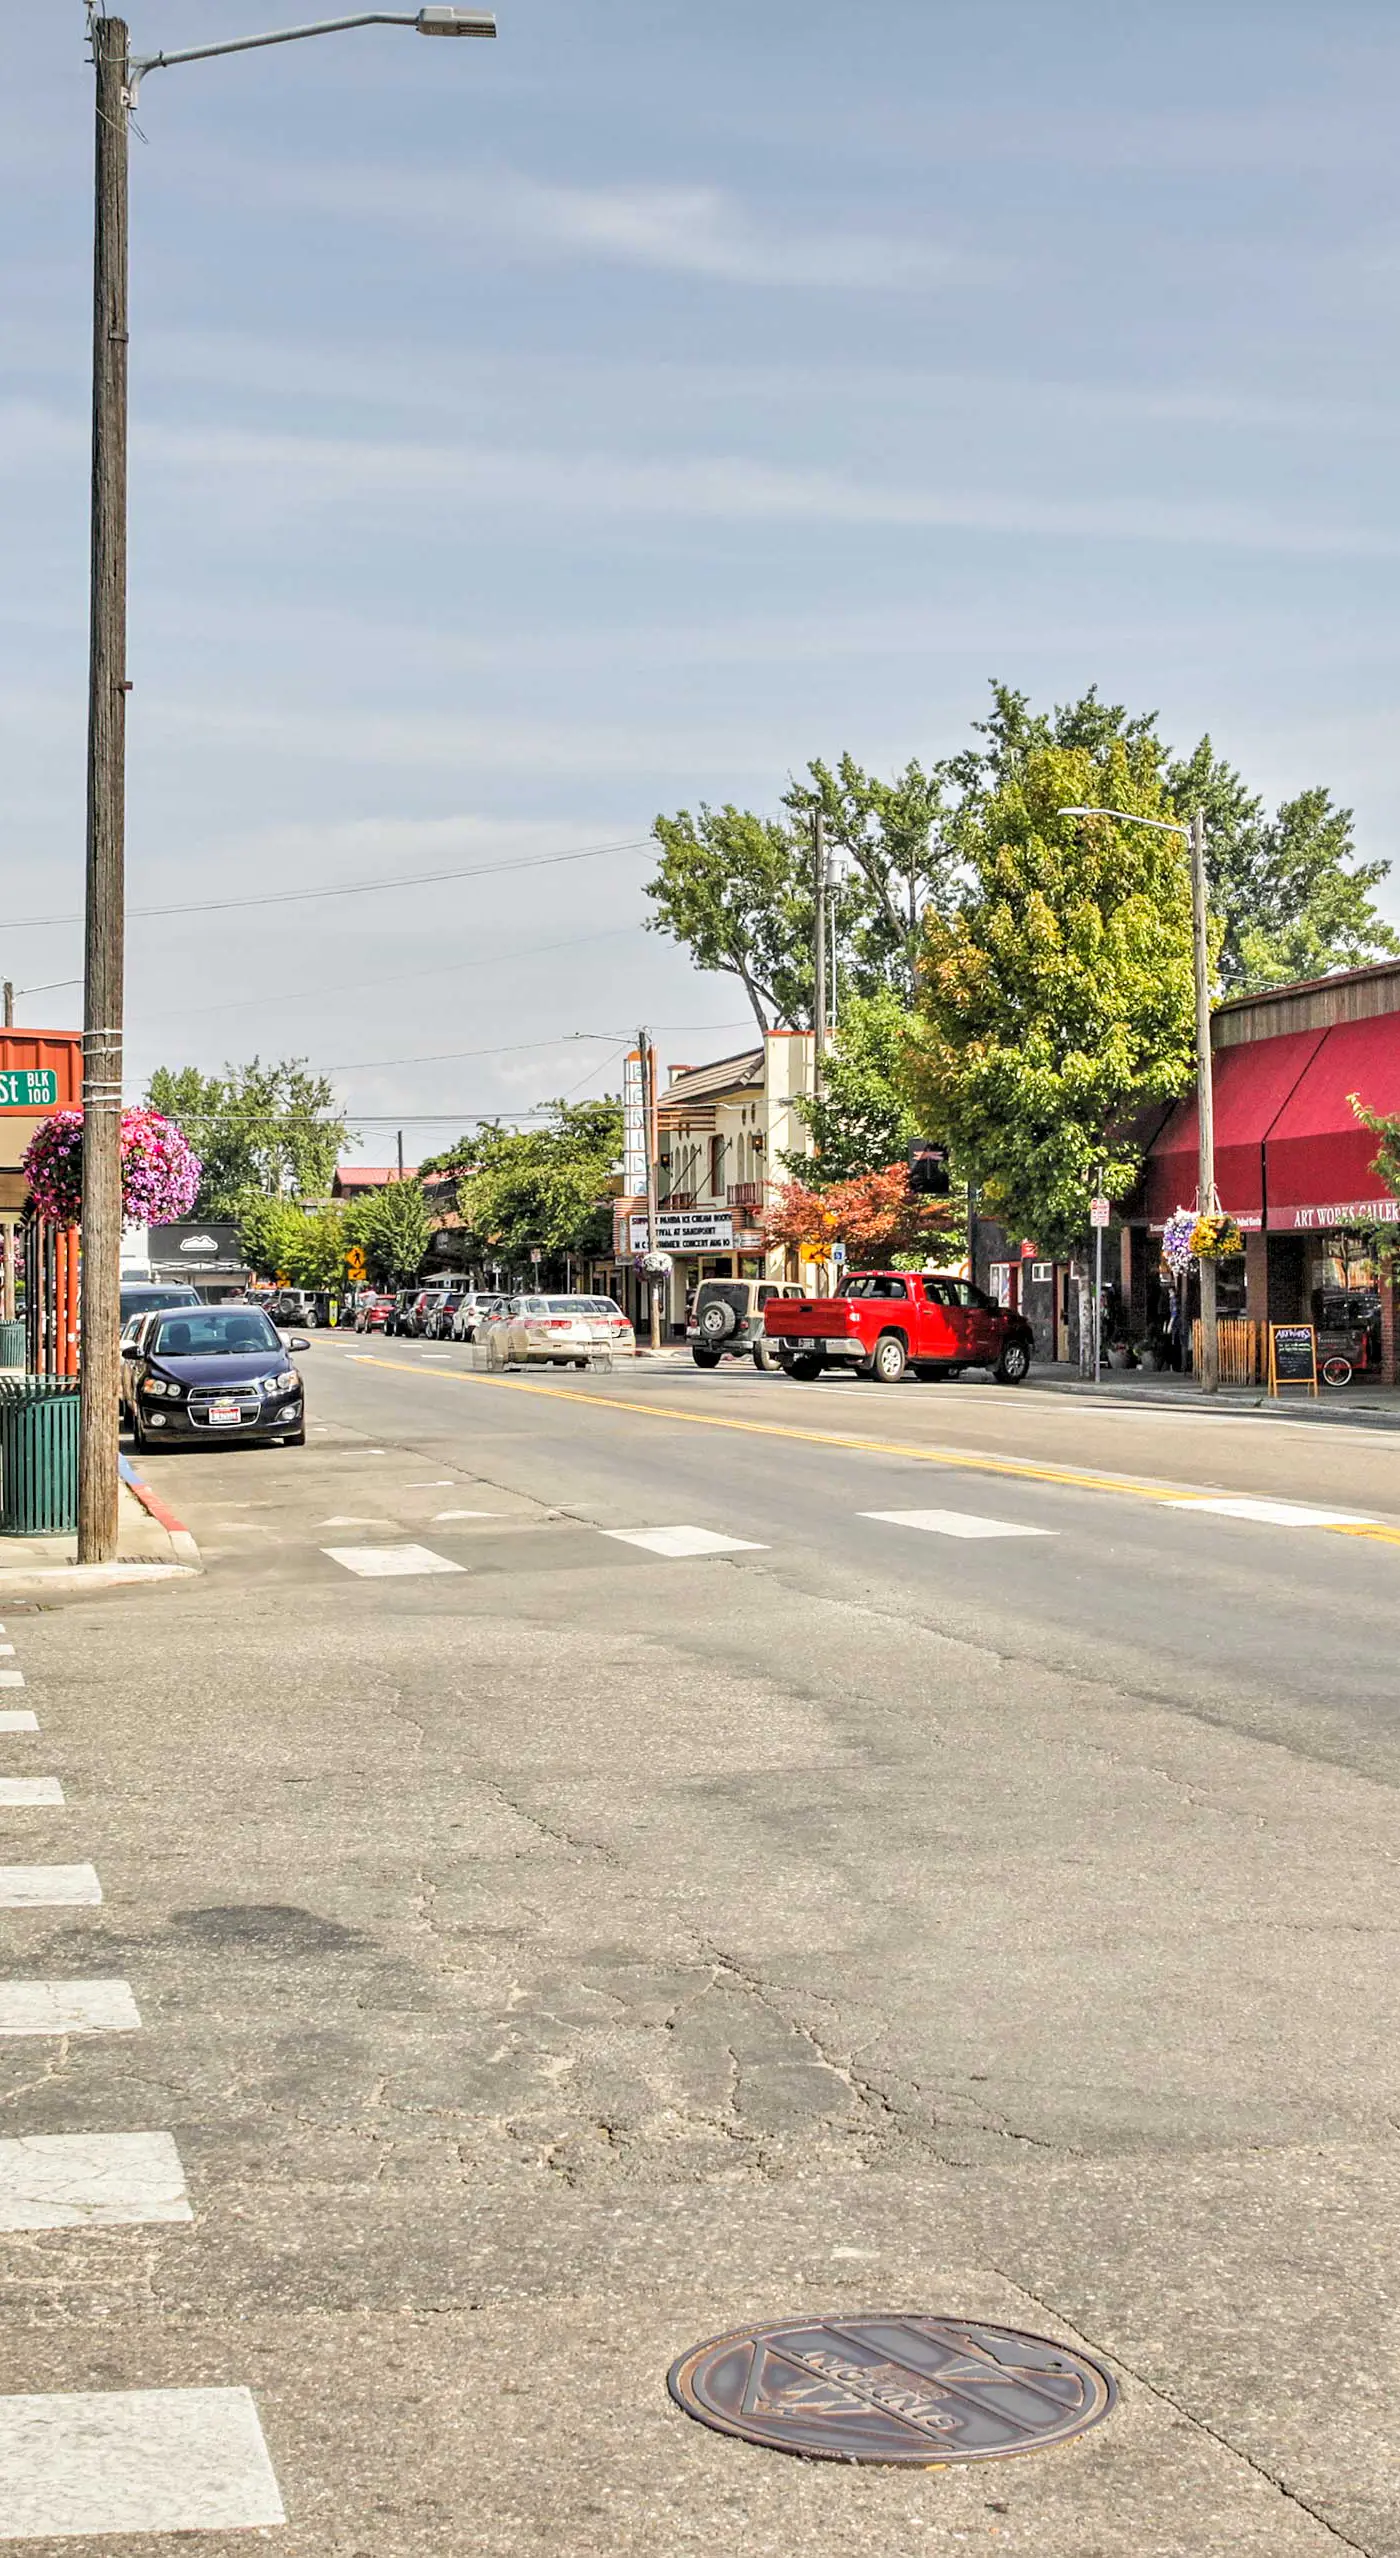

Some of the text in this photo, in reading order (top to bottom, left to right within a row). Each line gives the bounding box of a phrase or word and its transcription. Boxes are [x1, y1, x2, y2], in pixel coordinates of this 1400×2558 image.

[27, 1072, 49, 1087] BLK
[0, 1074, 19, 1103] St
[28, 1088, 50, 1103] 100
[1294, 1202, 1400, 1227] ART WORKS GALLER
[674, 1228, 680, 1236] AT
[683, 1239, 708, 1248] CONCERT
[710, 1239, 722, 1247] AUG
